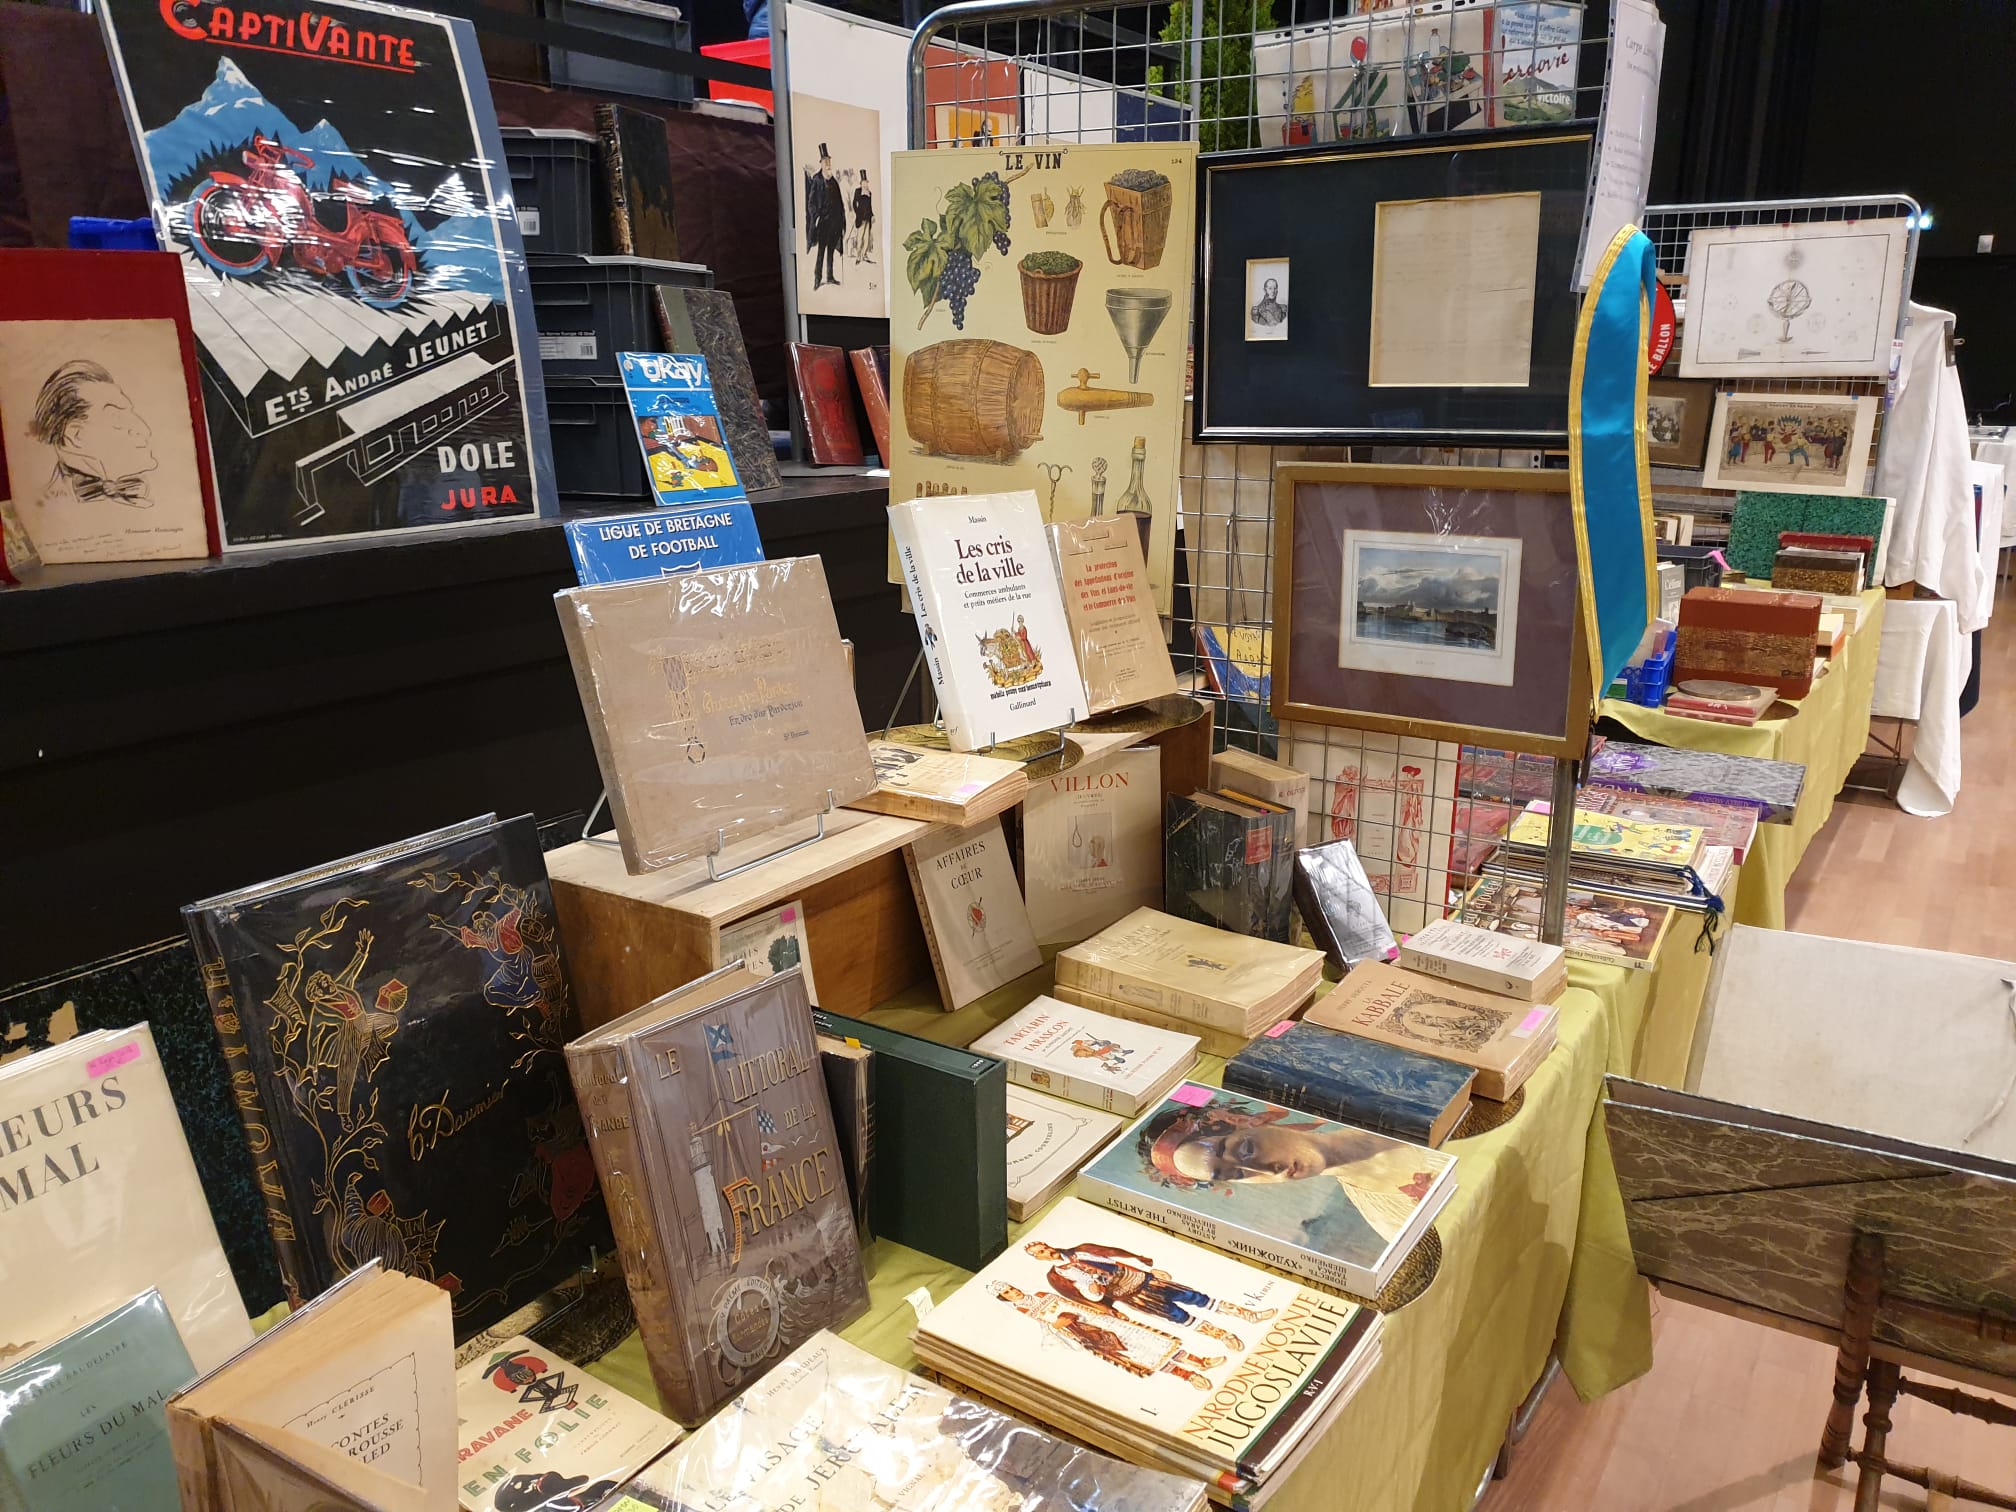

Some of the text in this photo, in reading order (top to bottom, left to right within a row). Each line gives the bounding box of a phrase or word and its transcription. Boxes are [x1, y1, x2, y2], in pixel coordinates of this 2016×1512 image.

[1005, 152, 1062, 171] LE VIN
[1652, 323, 1671, 362] BALLON
[325, 362, 394, 403] ANDRÉ
[404, 321, 488, 369] JEUNET
[437, 441, 516, 474] DOLE
[440, 485, 517, 510] JURA
[599, 512, 733, 542] LIGUE DE BRETAGNE
[968, 514, 988, 524] Massin
[628, 535, 719, 560] DE FOOTBALL
[904, 545, 914, 566] ville
[954, 534, 1013, 560] Les cris
[956, 557, 1026, 585] de la ville
[914, 586, 925, 605] cris
[964, 588, 998, 599] Commerces
[919, 604, 928, 619] Les
[1009, 697, 1038, 712] Gallimard
[1050, 772, 1129, 793] VILLON
[936, 841, 986, 871] AFFAIRES
[951, 867, 983, 890] CŒUR
[1351, 980, 1411, 1027] KABBALE
[1003, 1013, 1051, 1047] TARTARIN
[1024, 1019, 1069, 1053] TARASCON
[655, 1048, 681, 1081] LE
[727, 1040, 811, 1104] LITTORAL
[0, 1076, 126, 1158] EURS
[783, 1102, 817, 1130] DE LA
[0, 1142, 100, 1213] MAL
[722, 1148, 835, 1264] FRANCE
[1107, 1196, 1168, 1225] THE ARTIST
[1300, 1253, 1348, 1274] ШЕВЧЕНКО
[1308, 1268, 1348, 1287] ПОВЕСТЬ
[1316, 1263, 1348, 1280] ТАРАСА
[1207, 1300, 1349, 1451] JUGOSLAVIJE
[1183, 1359, 1272, 1440] NARODNE
[28, 1431, 96, 1480] FLEURS
[99, 1411, 127, 1436] DU
[131, 1388, 168, 1418] MAL
[462, 1464, 508, 1497] EN
[514, 1394, 609, 1464] FOLIE
